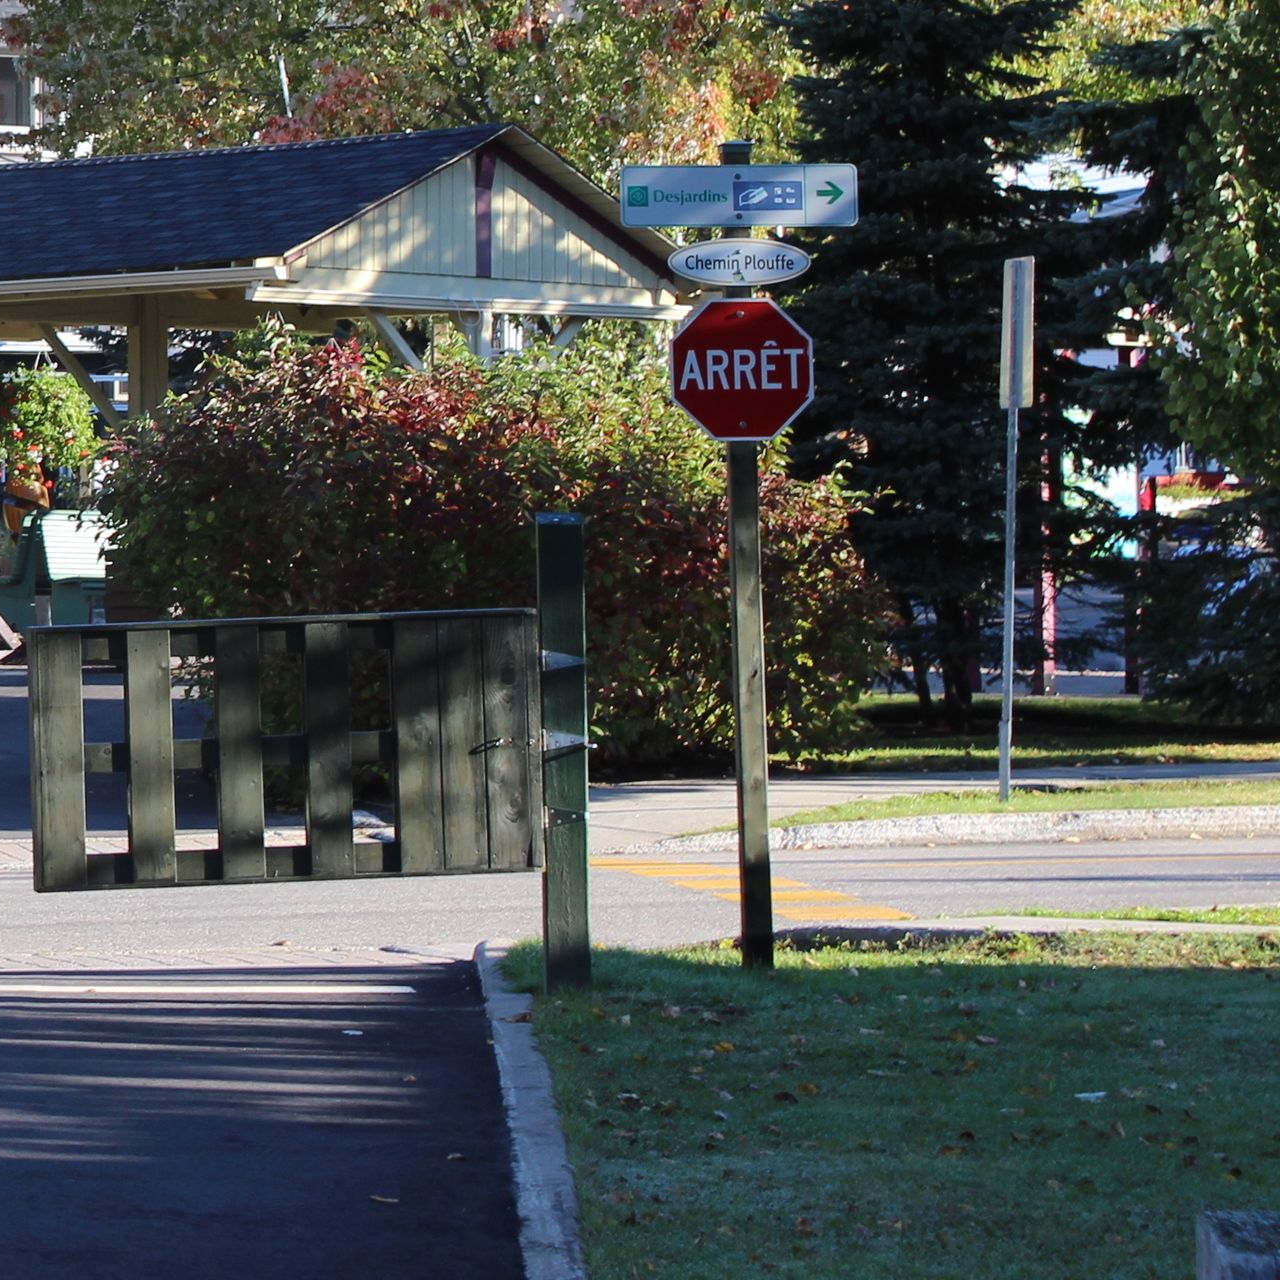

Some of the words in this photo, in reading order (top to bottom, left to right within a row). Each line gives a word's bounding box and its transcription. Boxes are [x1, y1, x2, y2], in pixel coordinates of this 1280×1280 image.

[653, 190, 728, 205] Desjardins
[685, 255, 740, 270] Chemin
[745, 255, 794, 270] Plouffe
[680, 341, 803, 390] ARRÊT
